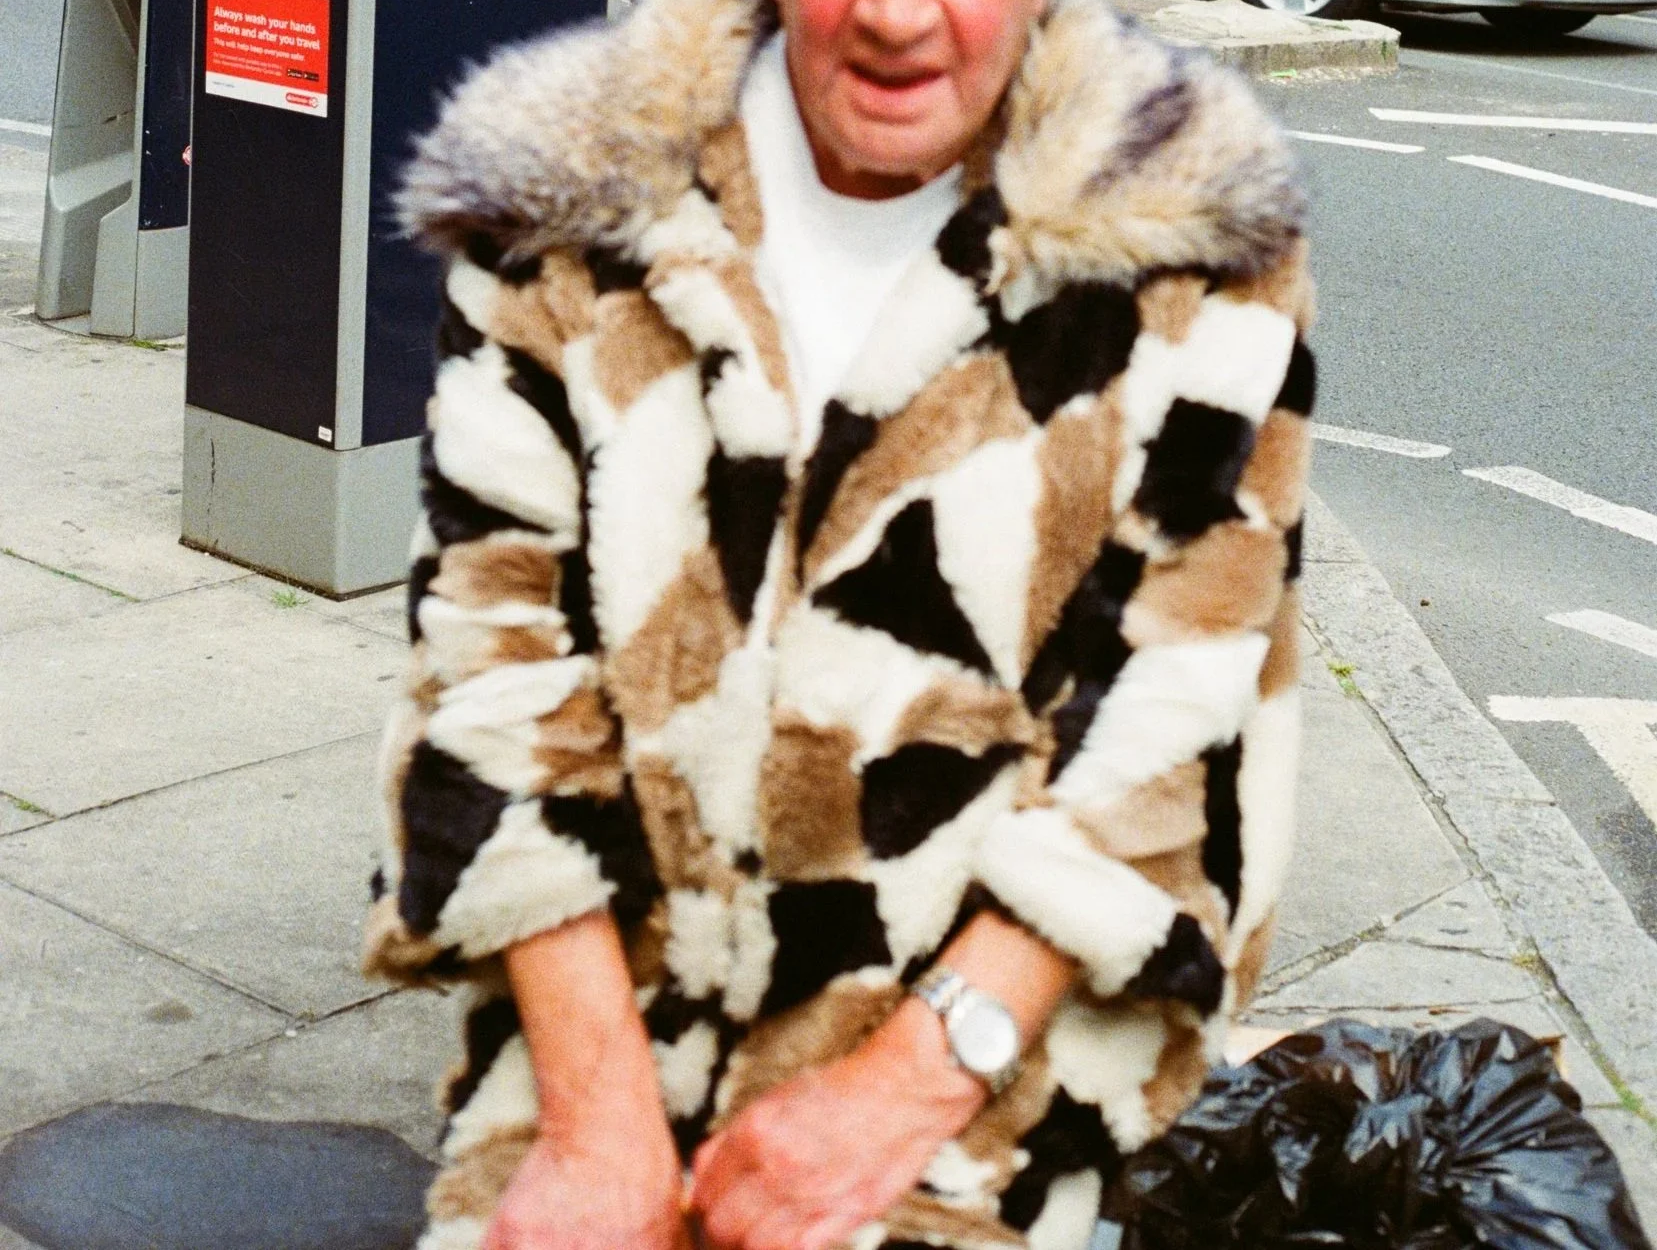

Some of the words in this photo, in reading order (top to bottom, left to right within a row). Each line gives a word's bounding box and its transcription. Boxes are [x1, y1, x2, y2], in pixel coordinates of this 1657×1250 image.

[214, 6, 243, 23] Always
[245, 13, 267, 25] wash
[268, 18, 288, 29] your
[290, 20, 316, 35] hands
[213, 22, 240, 34] before
[241, 27, 256, 38] and
[258, 30, 278, 43] after
[279, 35, 295, 46] you
[296, 37, 320, 51] travel
